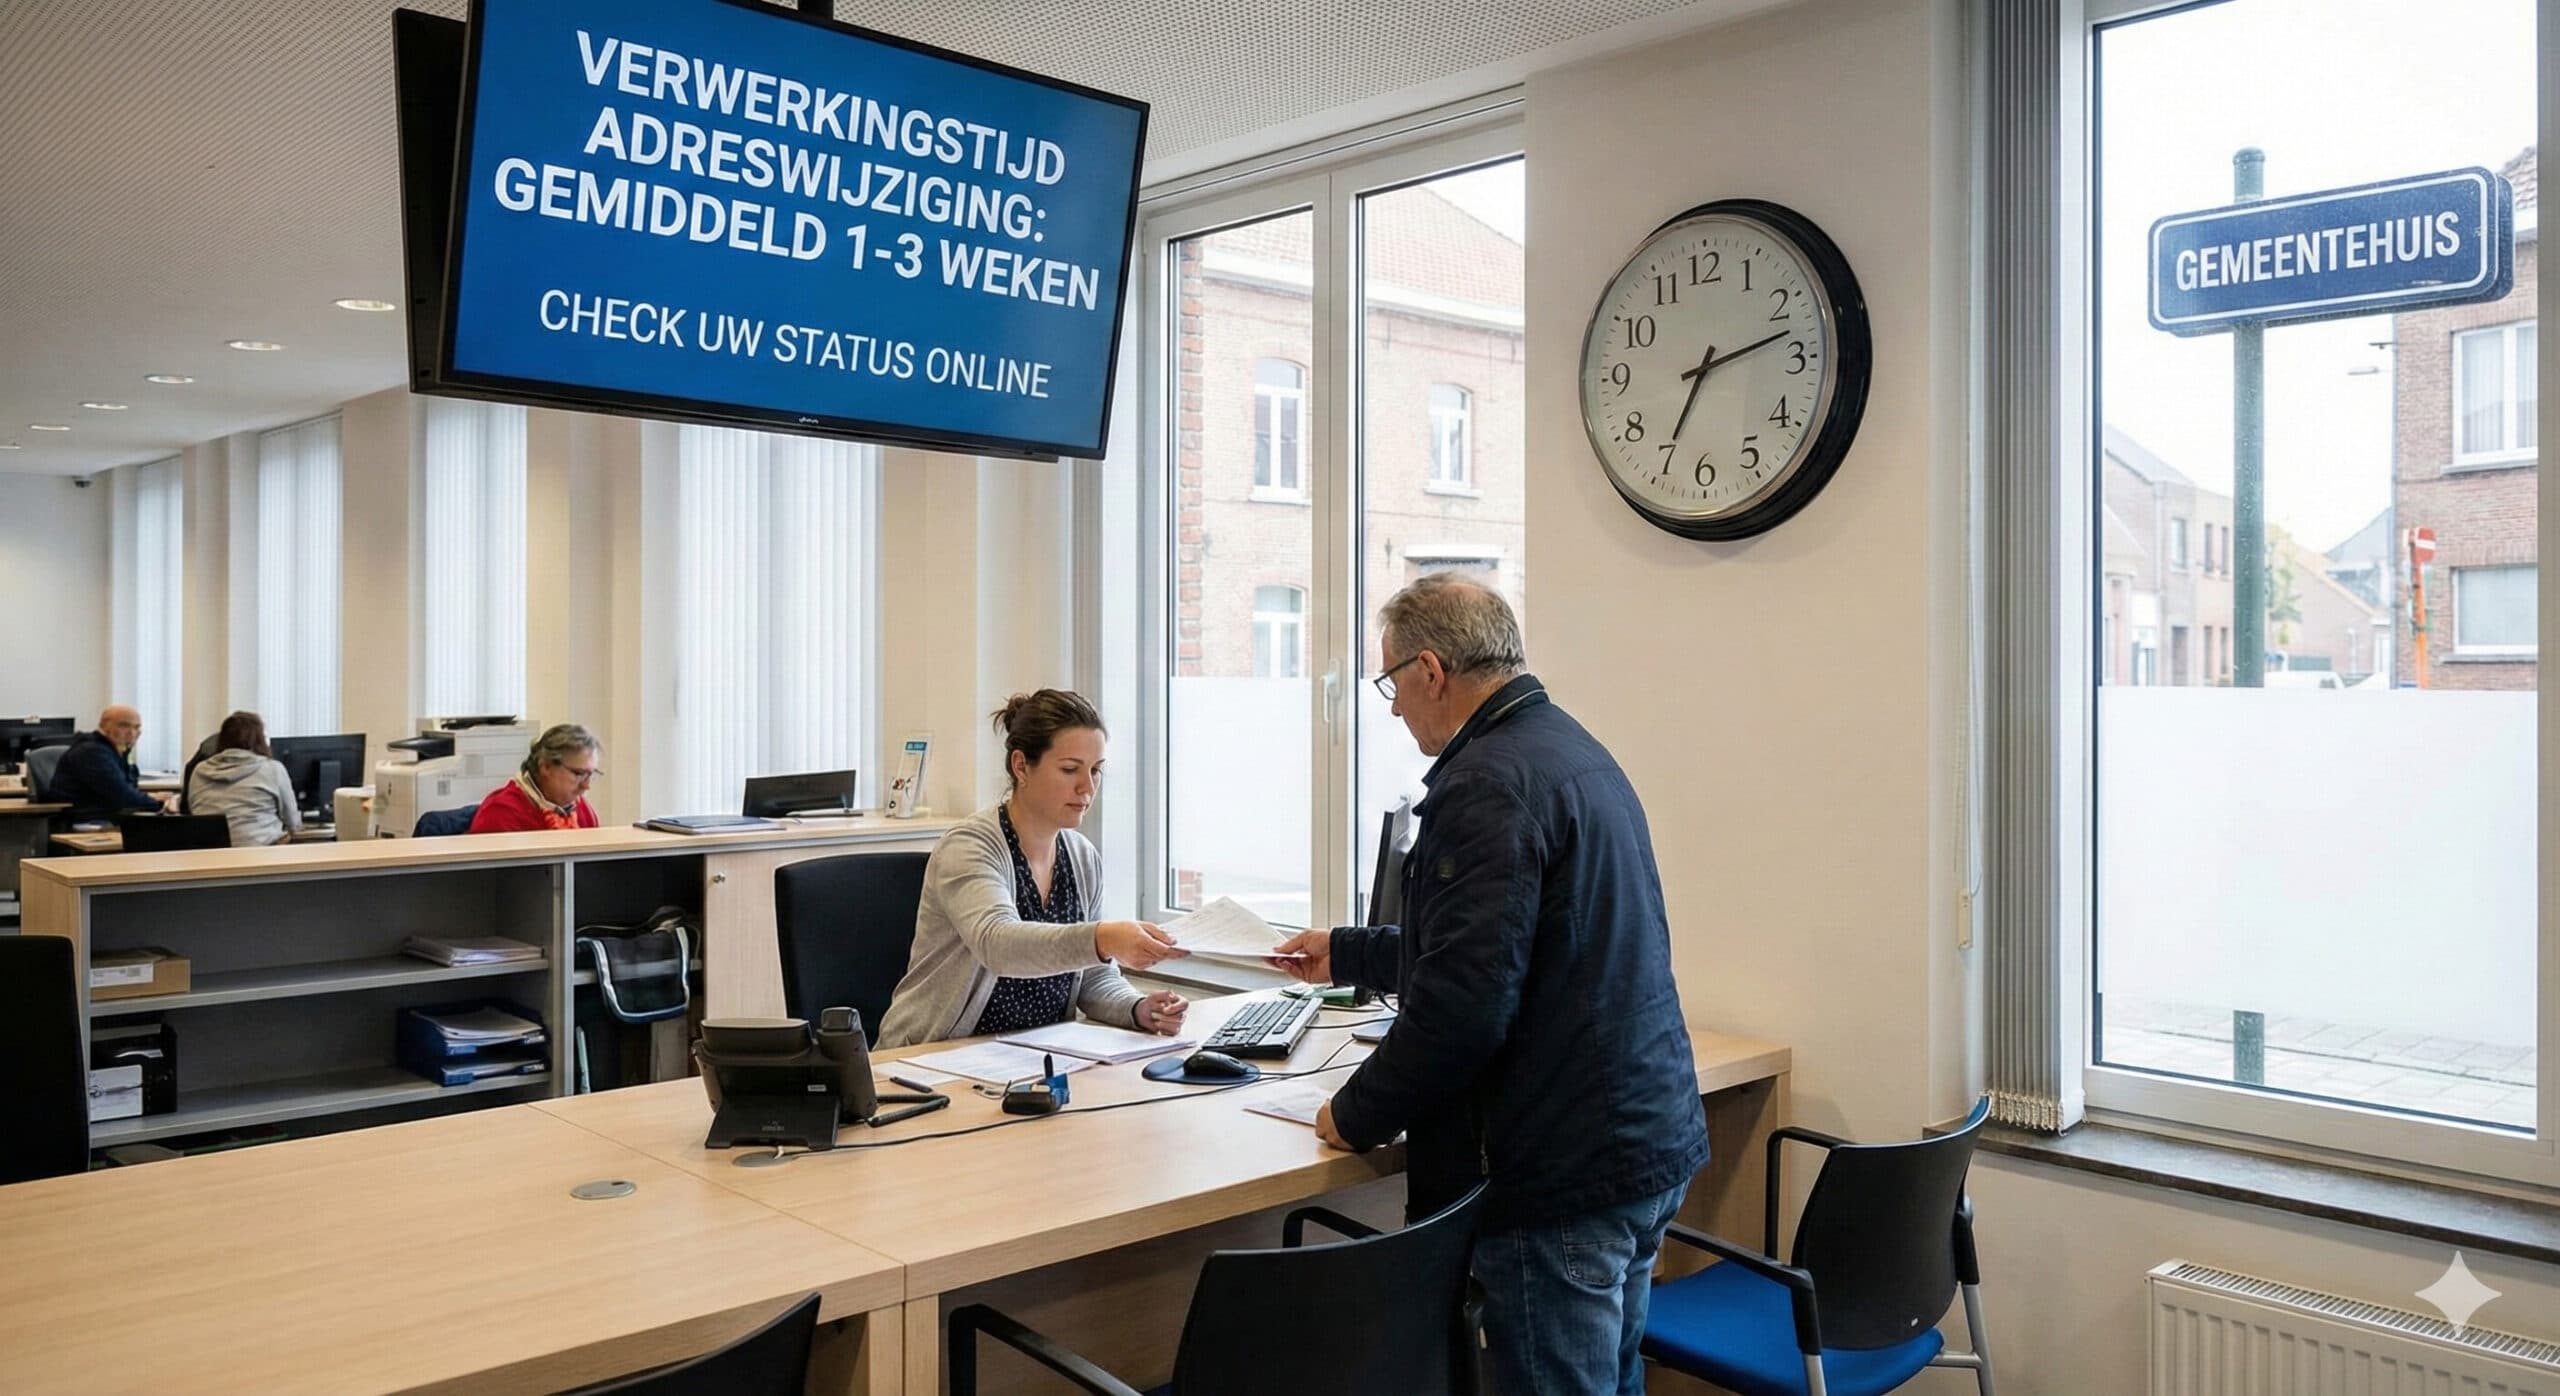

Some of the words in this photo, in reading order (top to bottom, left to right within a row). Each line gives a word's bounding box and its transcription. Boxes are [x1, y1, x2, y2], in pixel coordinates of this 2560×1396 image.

[576, 30, 1065, 186] VERWERKINGSTIJD
[584, 106, 1046, 243] ADRESWIJZIGING:
[494, 157, 827, 261] GEMIDDELD
[847, 225, 924, 279] 1-3
[939, 239, 1100, 311] WEKEN
[2176, 211, 2460, 291] GEMEENTEHUIS
[1687, 251, 1722, 287] 12
[1740, 258, 1754, 293] 1
[1652, 272, 1681, 306] 11
[1768, 287, 1791, 322] 2
[540, 289, 687, 348] CHECK
[698, 312, 764, 357] UW
[773, 324, 915, 379] STATUS
[926, 347, 1053, 399] ONLINE
[1622, 314, 1657, 350] 10
[1784, 340, 1807, 376] 3
[1611, 362, 1631, 397] 9
[1624, 411, 1645, 443] 8
[1767, 394, 1791, 429] 4
[1658, 443, 1677, 476] 7
[1694, 452, 1716, 487] 6
[1739, 434, 1760, 470] 5
